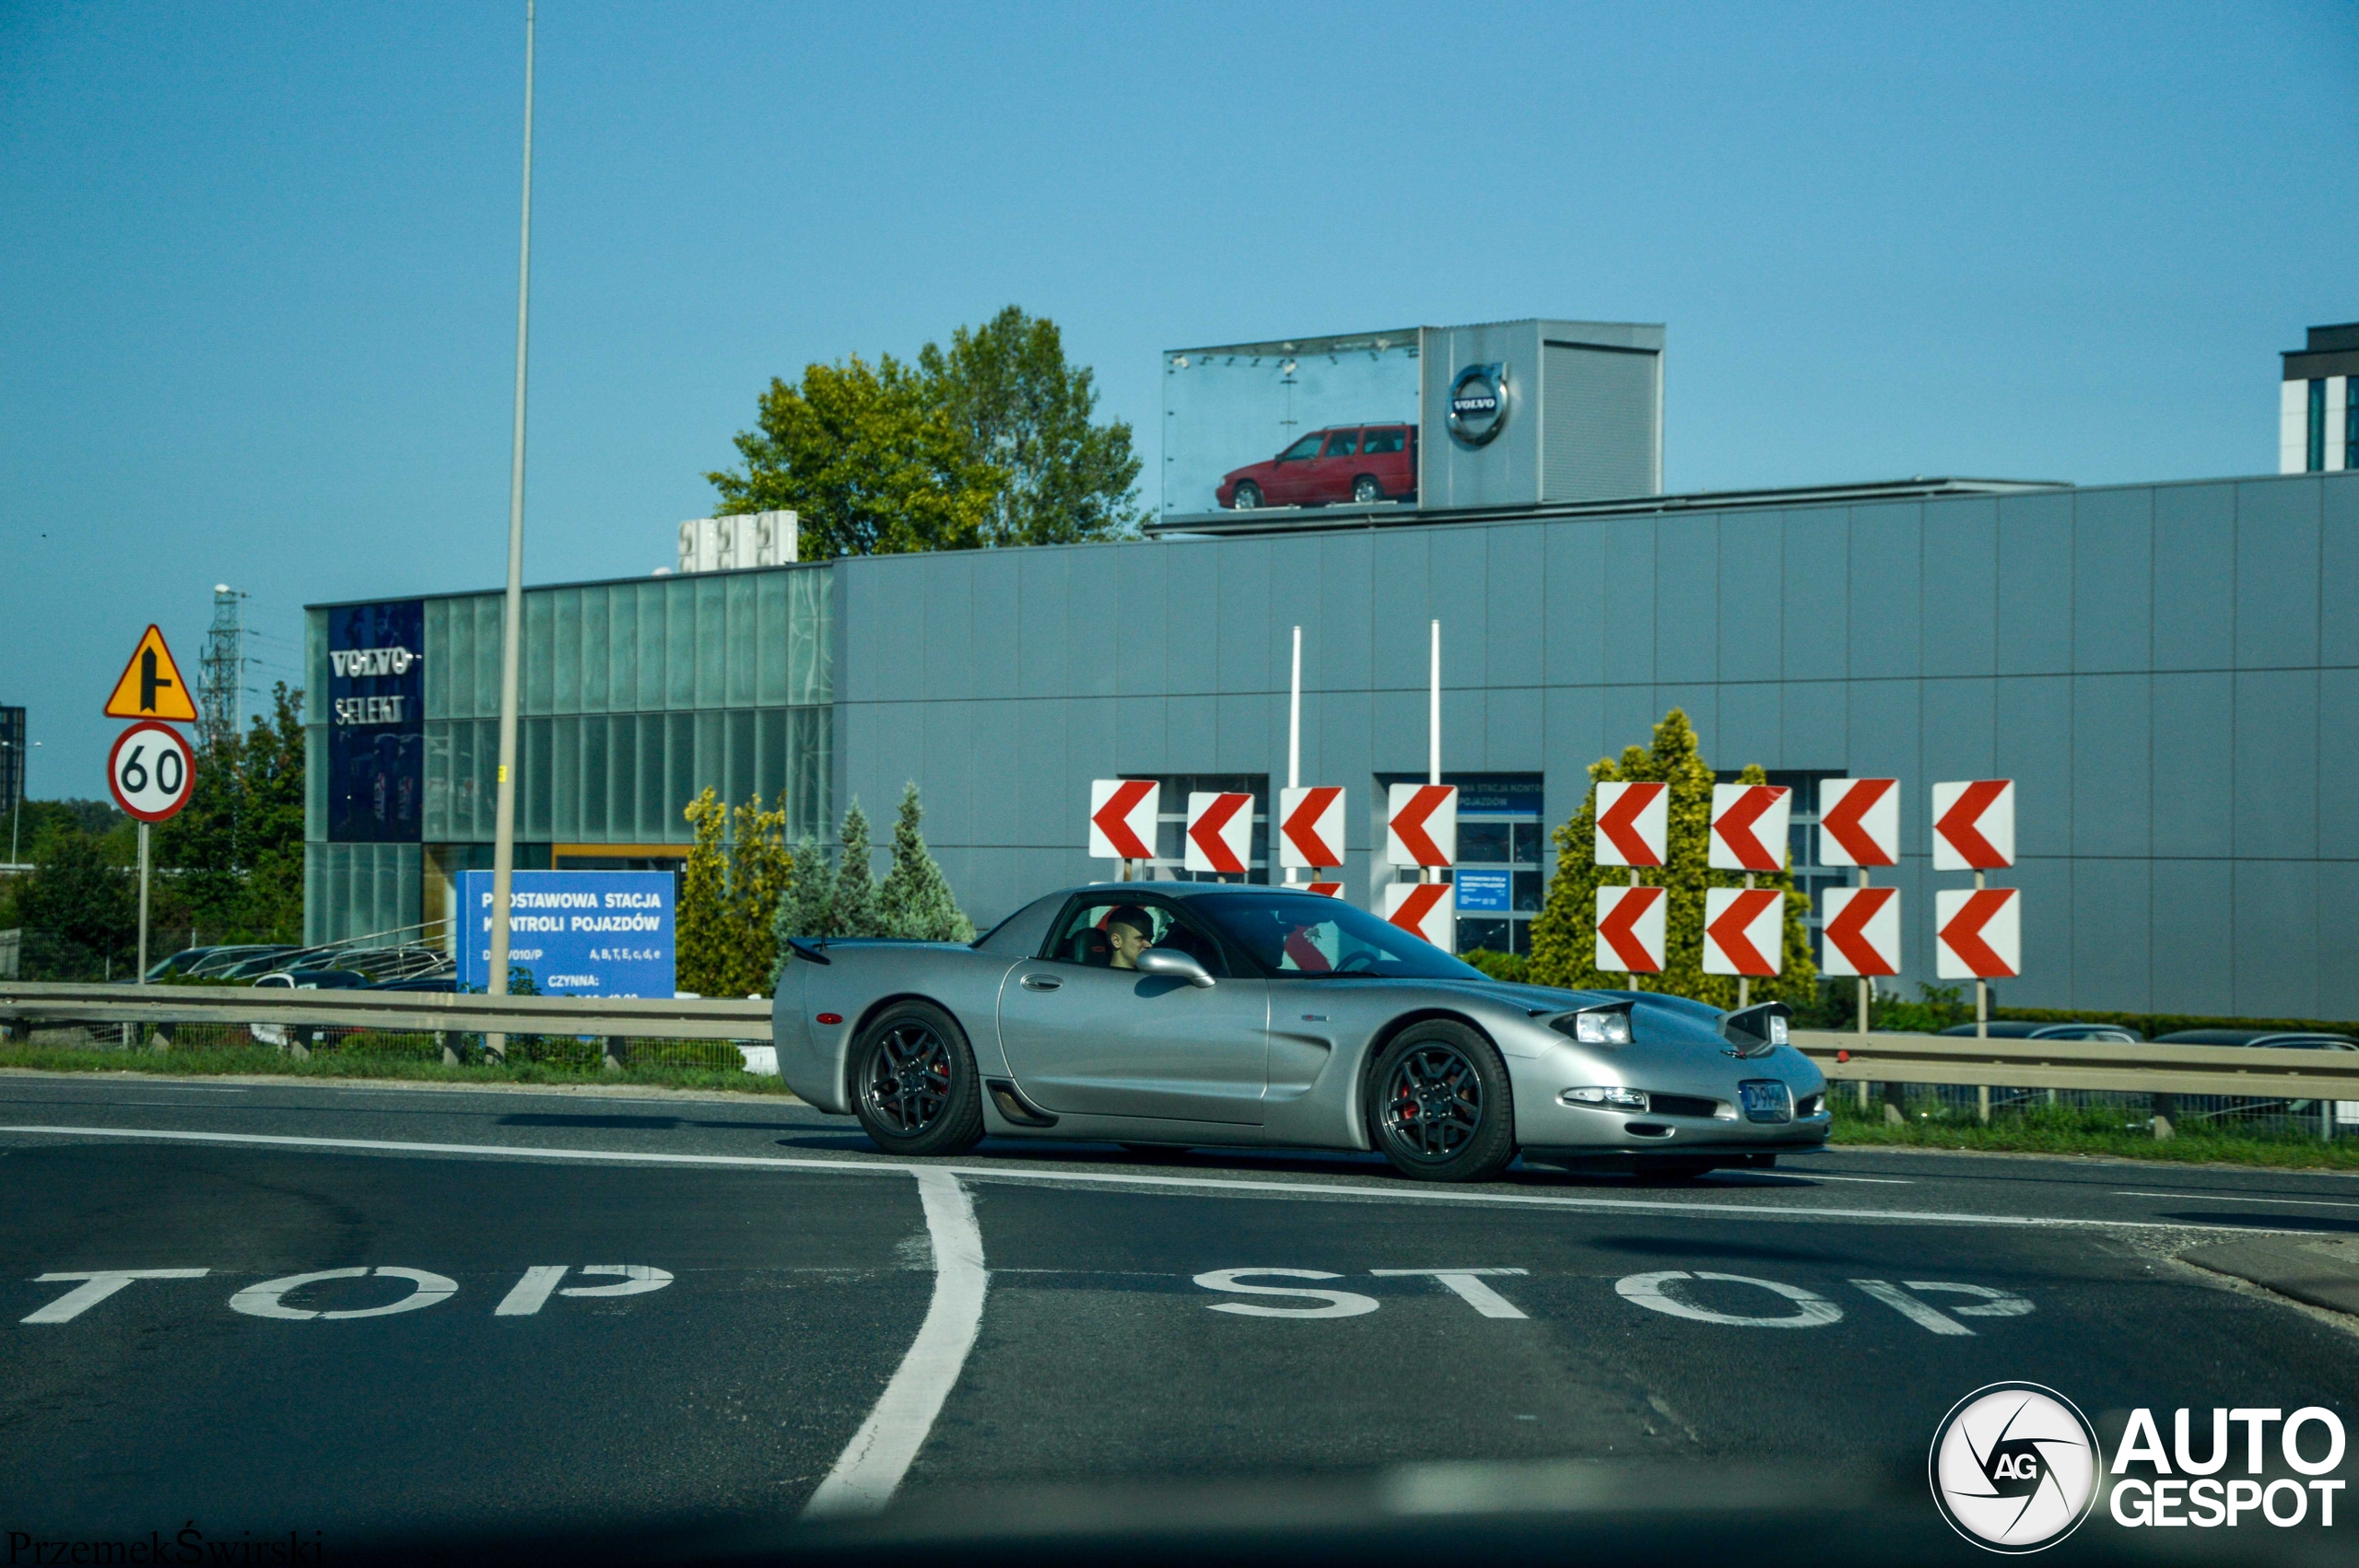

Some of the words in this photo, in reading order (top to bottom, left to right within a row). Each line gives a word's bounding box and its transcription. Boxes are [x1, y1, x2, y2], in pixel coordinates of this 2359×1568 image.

[1454, 398, 1495, 410] VOLVO
[330, 647, 408, 677] VOLVO
[335, 696, 405, 725] SELEKT
[121, 745, 182, 795] 60
[604, 893, 662, 908] STACJA
[484, 916, 564, 932] KNTROLI
[571, 912, 660, 931] POJAZDÓW
[547, 975, 599, 988] CZYNNA:
[1192, 1268, 2037, 1337] STOP
